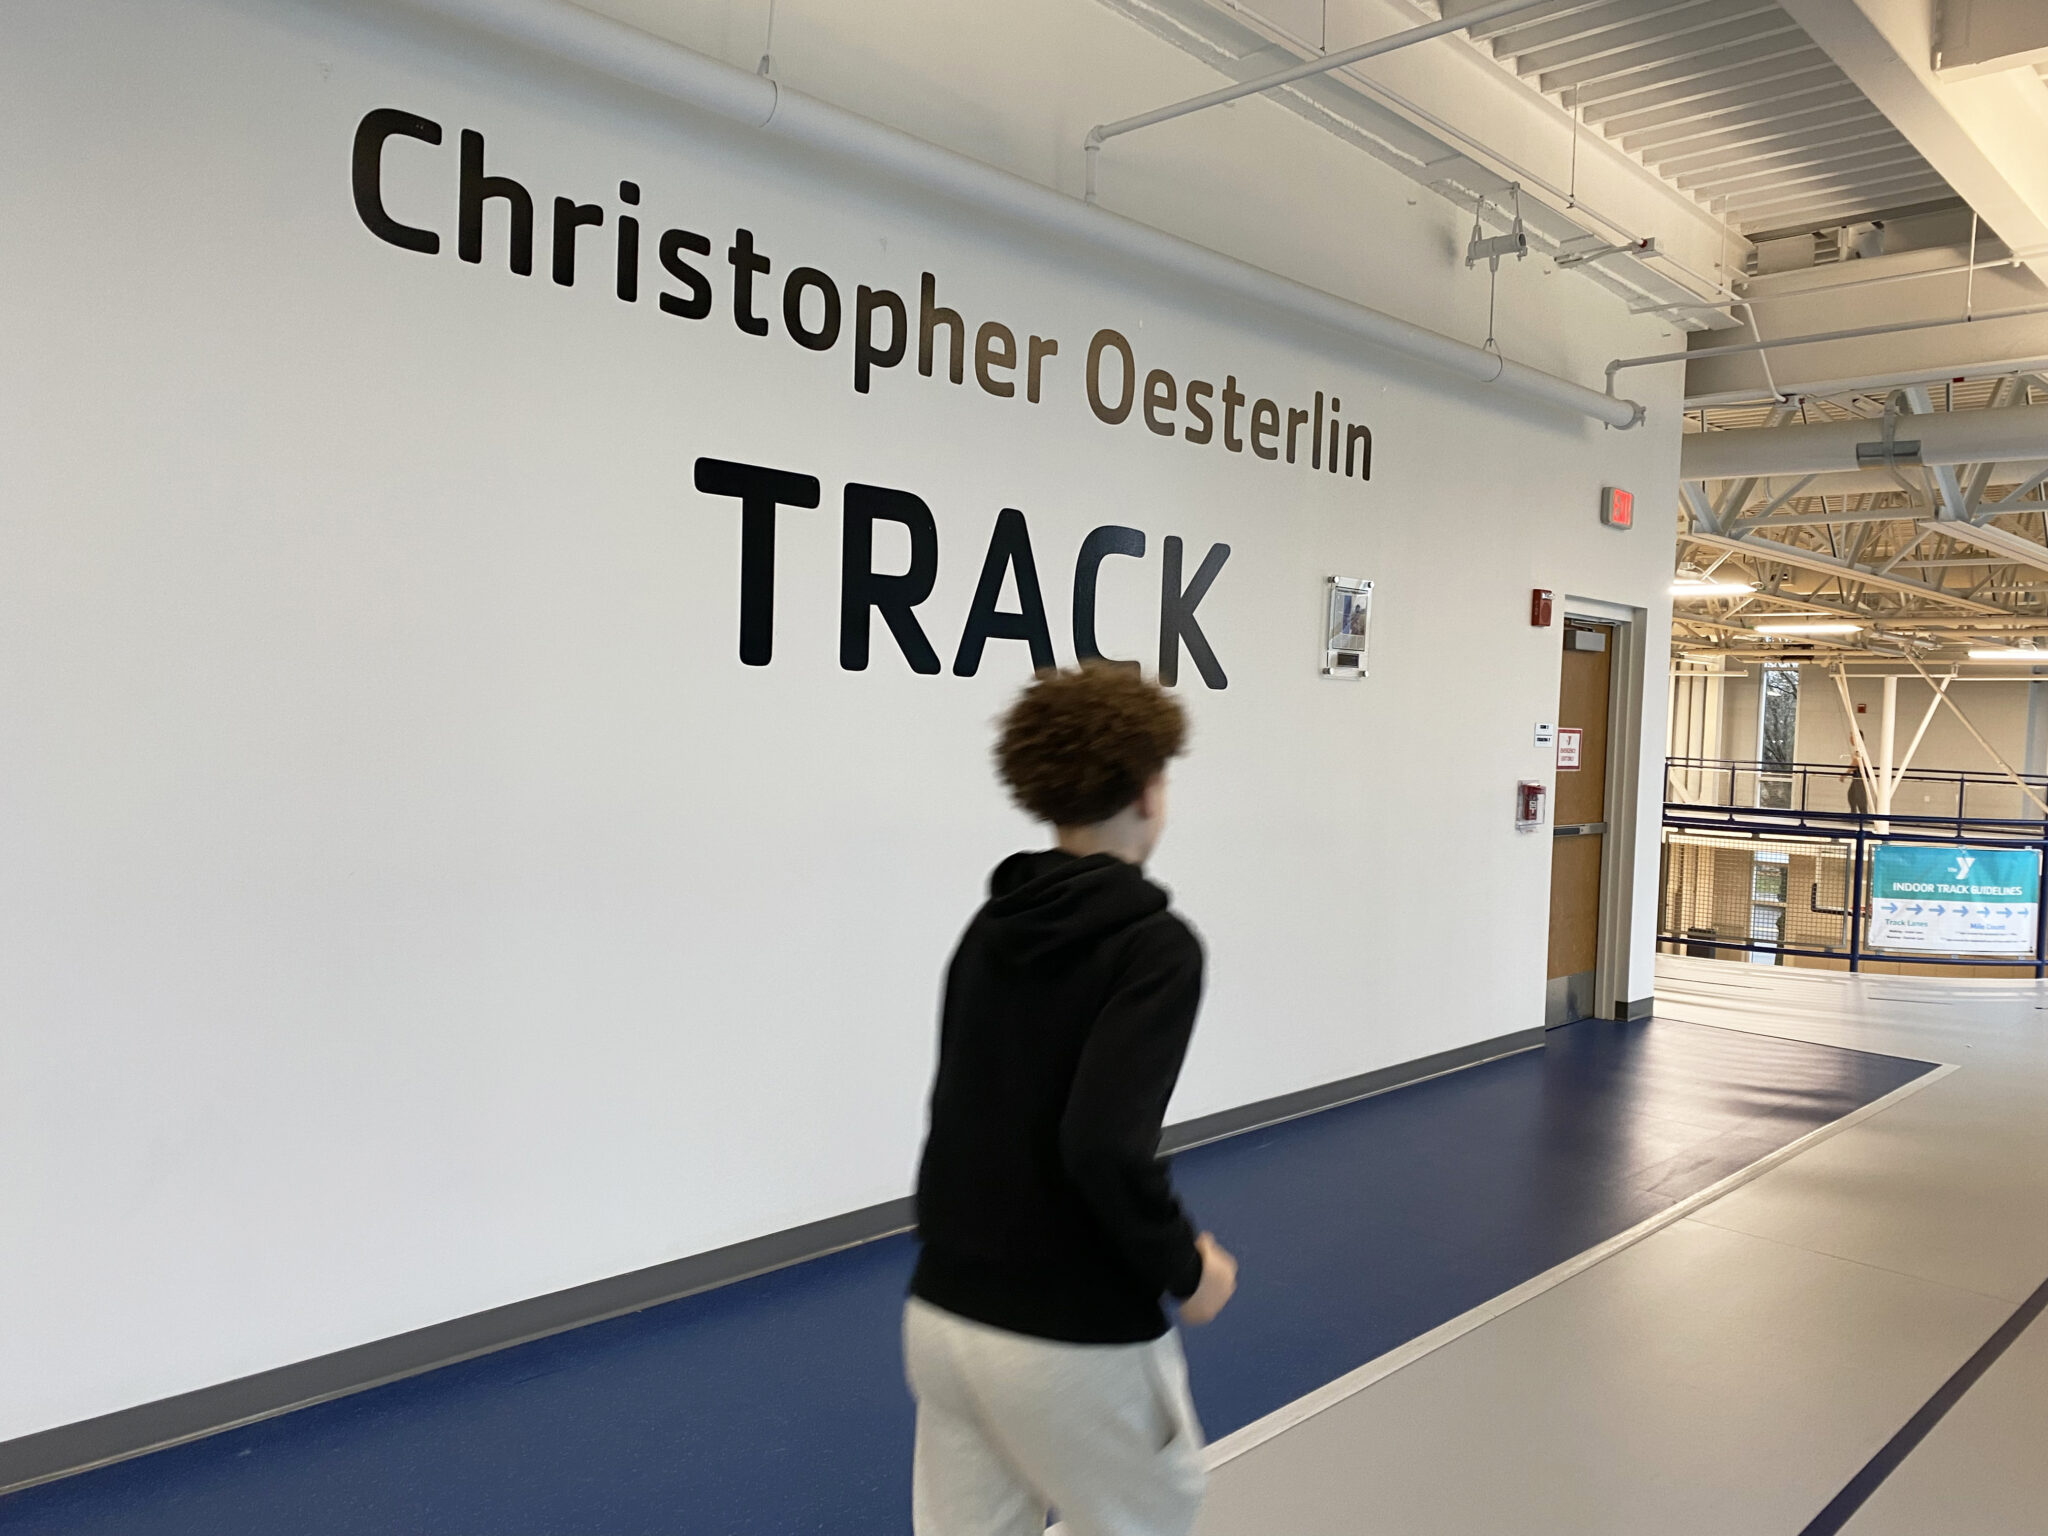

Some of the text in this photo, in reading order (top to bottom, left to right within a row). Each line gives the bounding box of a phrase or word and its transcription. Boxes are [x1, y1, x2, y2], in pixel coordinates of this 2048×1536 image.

[352, 107, 1373, 482] Christopher Oesterlin
[693, 456, 1231, 690] TRACK
[1885, 918, 1905, 926] Track
[1892, 882, 2023, 896] INDOOR TRACK GUIDELINES
